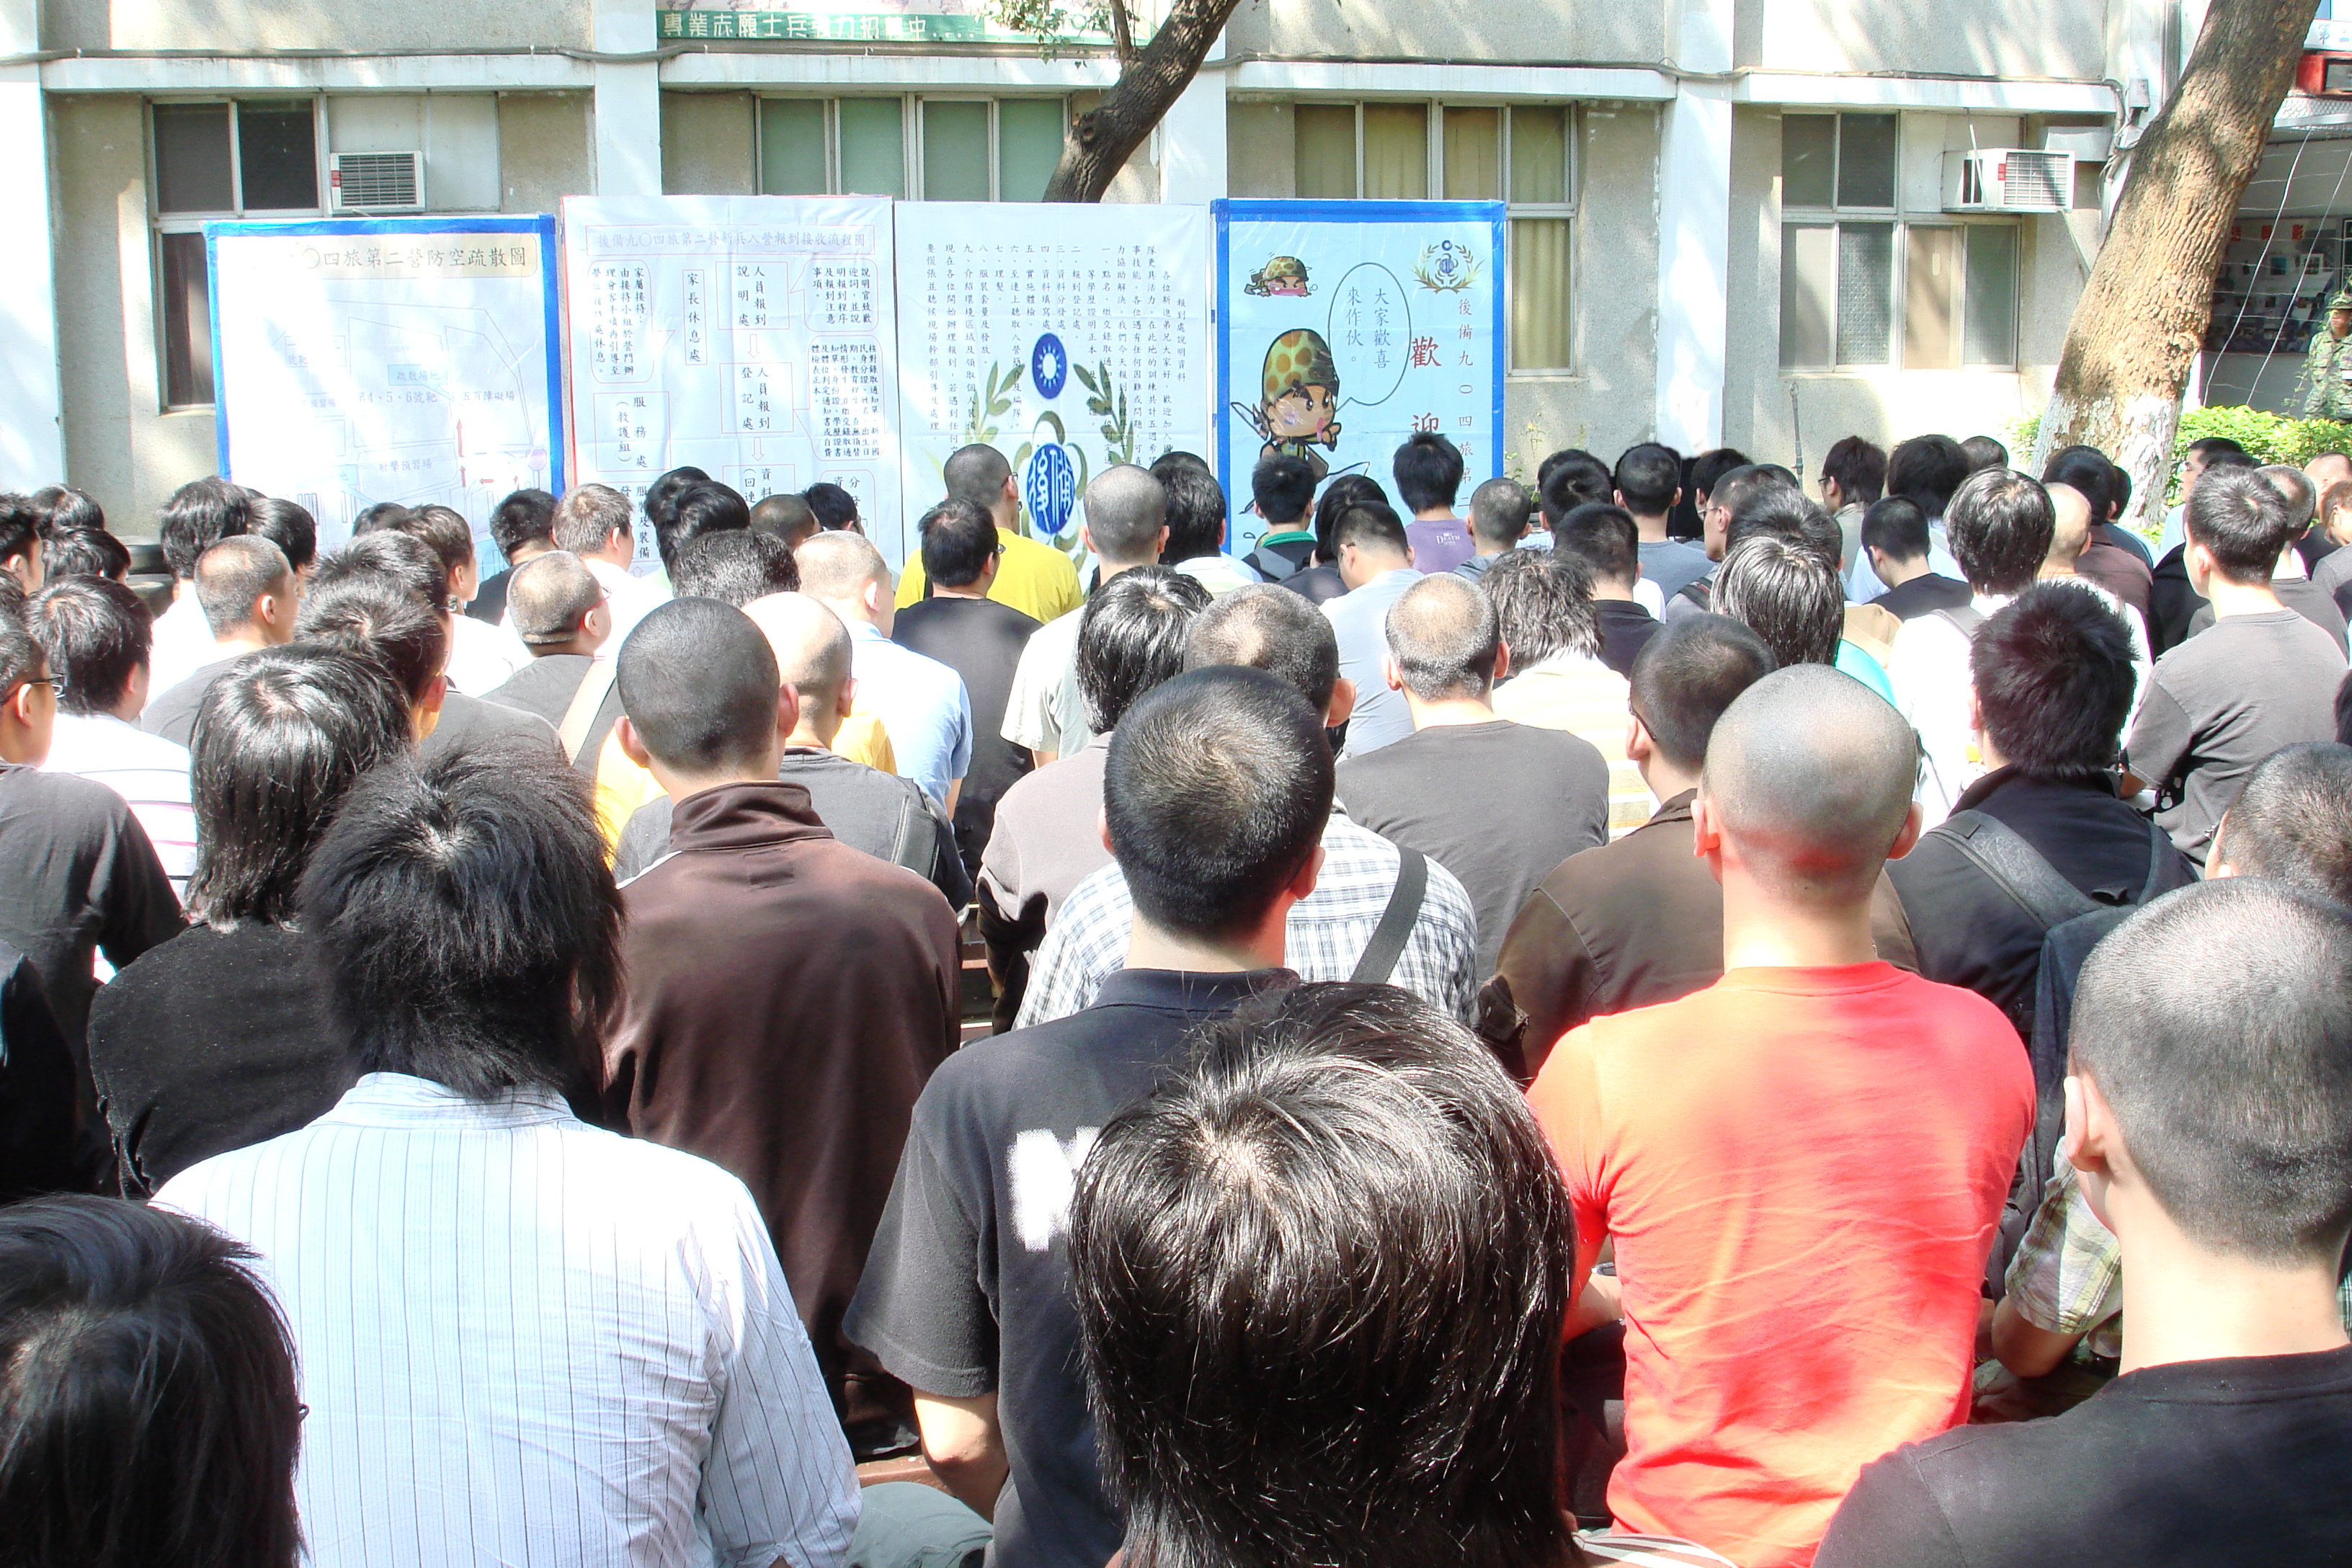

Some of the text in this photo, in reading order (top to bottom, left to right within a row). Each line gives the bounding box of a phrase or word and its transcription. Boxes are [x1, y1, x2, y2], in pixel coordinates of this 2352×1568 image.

[687, 274, 701, 362] 家長休息處
[737, 266, 749, 325] 說明處
[754, 266, 766, 325] 人員報到
[1373, 288, 1391, 369] 大家歡喜
[741, 367, 754, 430] 登記處
[757, 367, 770, 429] 人員報到
[1409, 336, 1441, 434] 歡迎
[633, 396, 648, 468] 服務處
